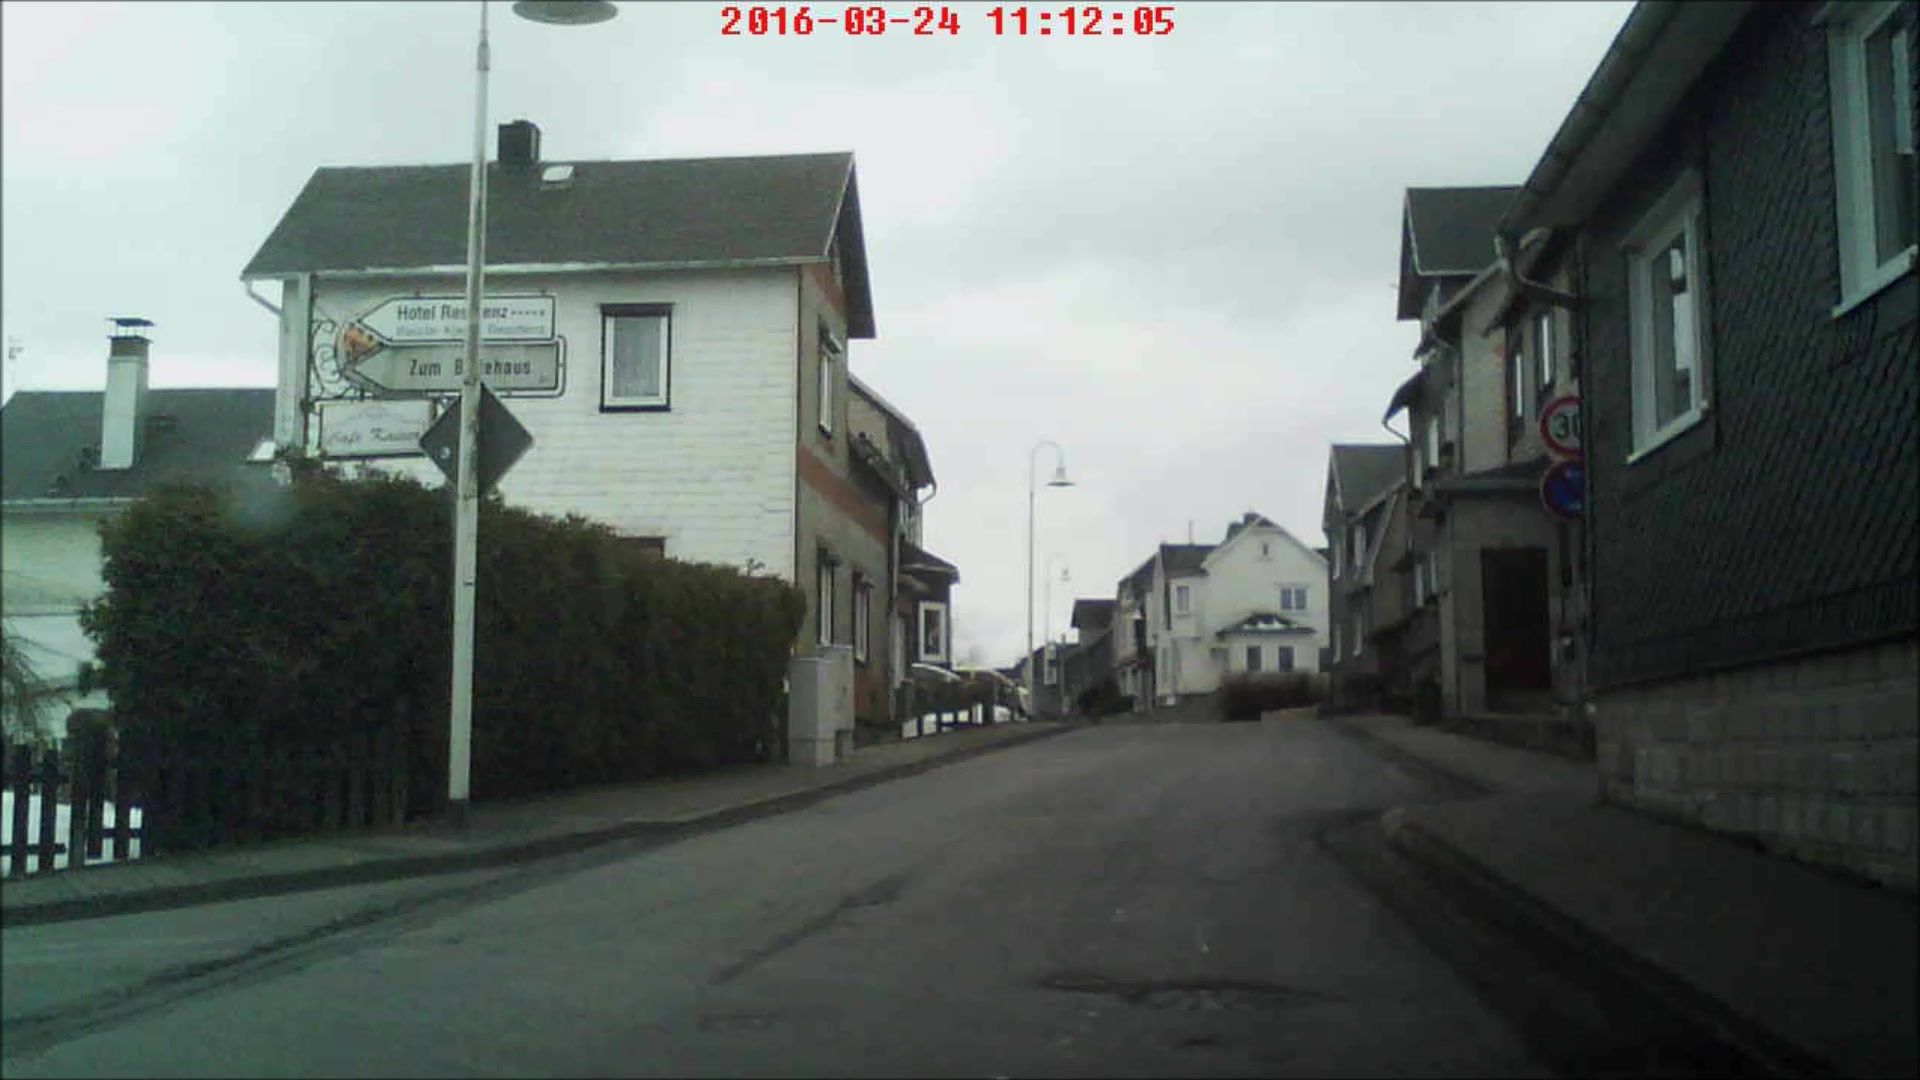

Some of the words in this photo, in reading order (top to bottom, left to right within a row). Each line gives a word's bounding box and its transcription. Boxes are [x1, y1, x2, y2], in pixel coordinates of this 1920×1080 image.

[397, 304, 436, 321] Hotel
[441, 303, 508, 320] Resenz
[409, 358, 442, 377] Zum
[454, 359, 531, 376] Behaus
